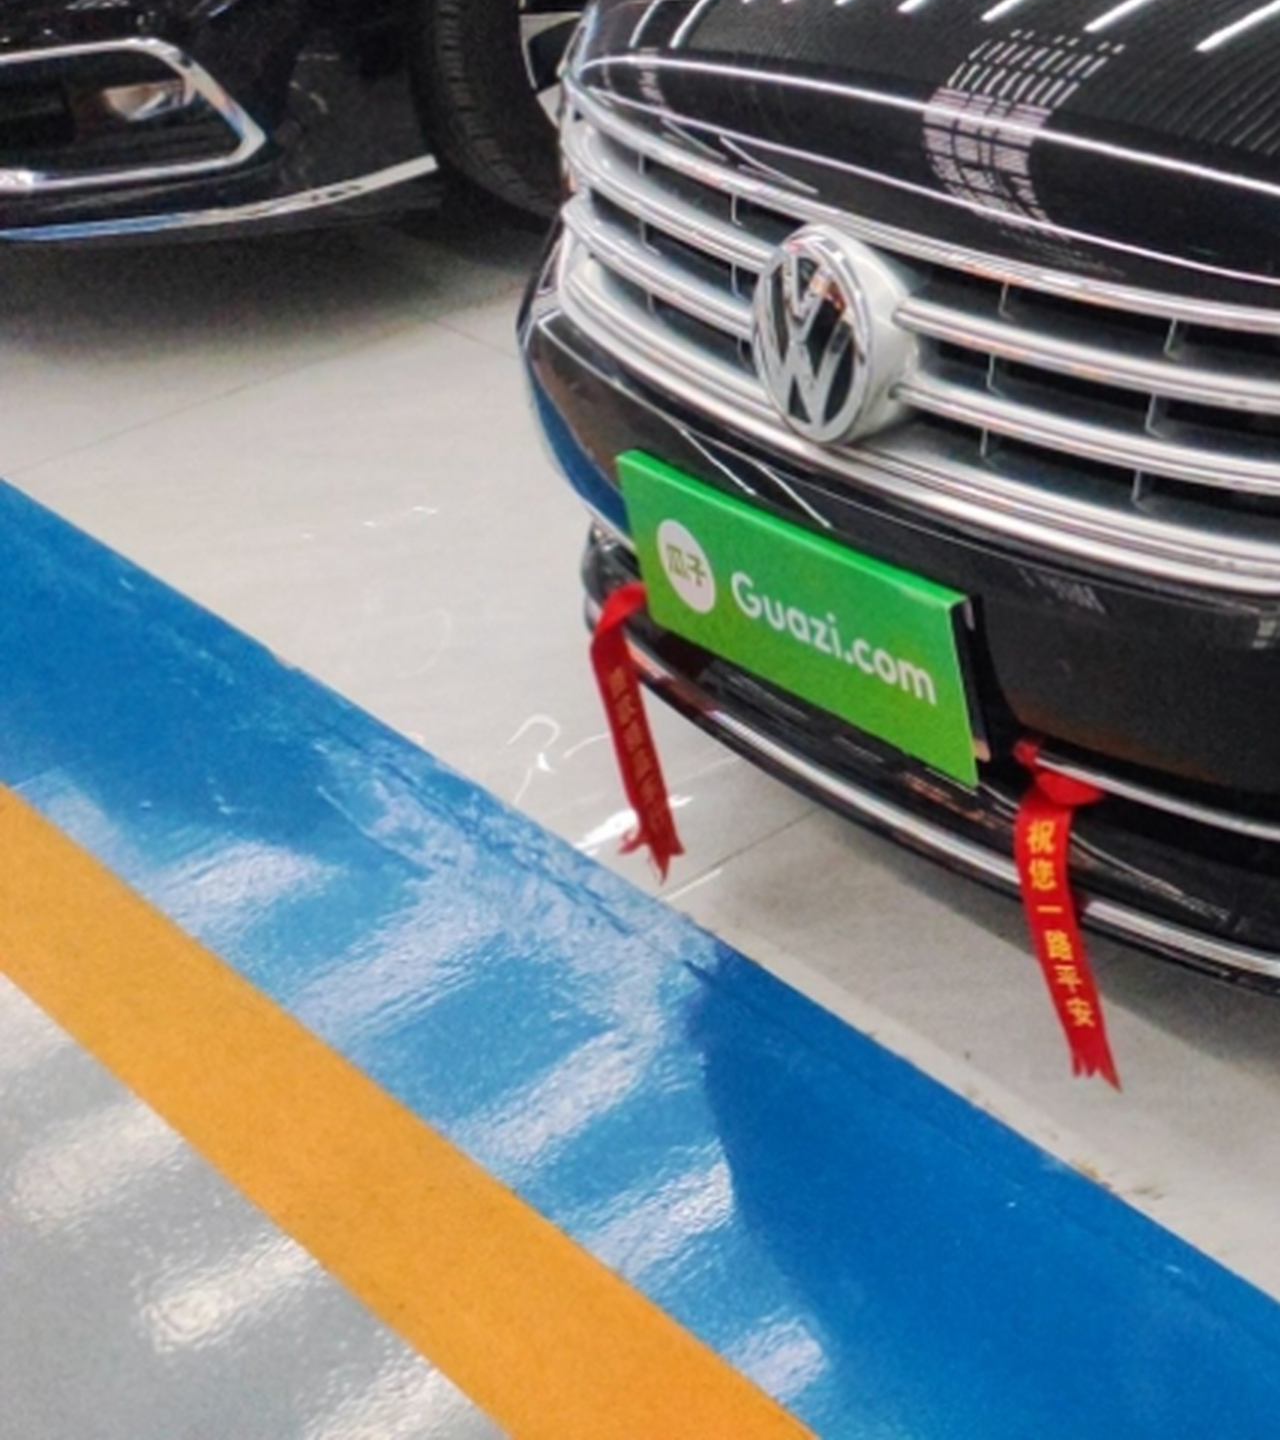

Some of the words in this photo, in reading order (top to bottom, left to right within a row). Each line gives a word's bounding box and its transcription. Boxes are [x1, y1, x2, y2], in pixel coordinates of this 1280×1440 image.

[665, 543, 707, 589] 瓜子
[731, 571, 937, 707] Guazi.com
[1026, 819, 1096, 1028] 祝您一路平安
